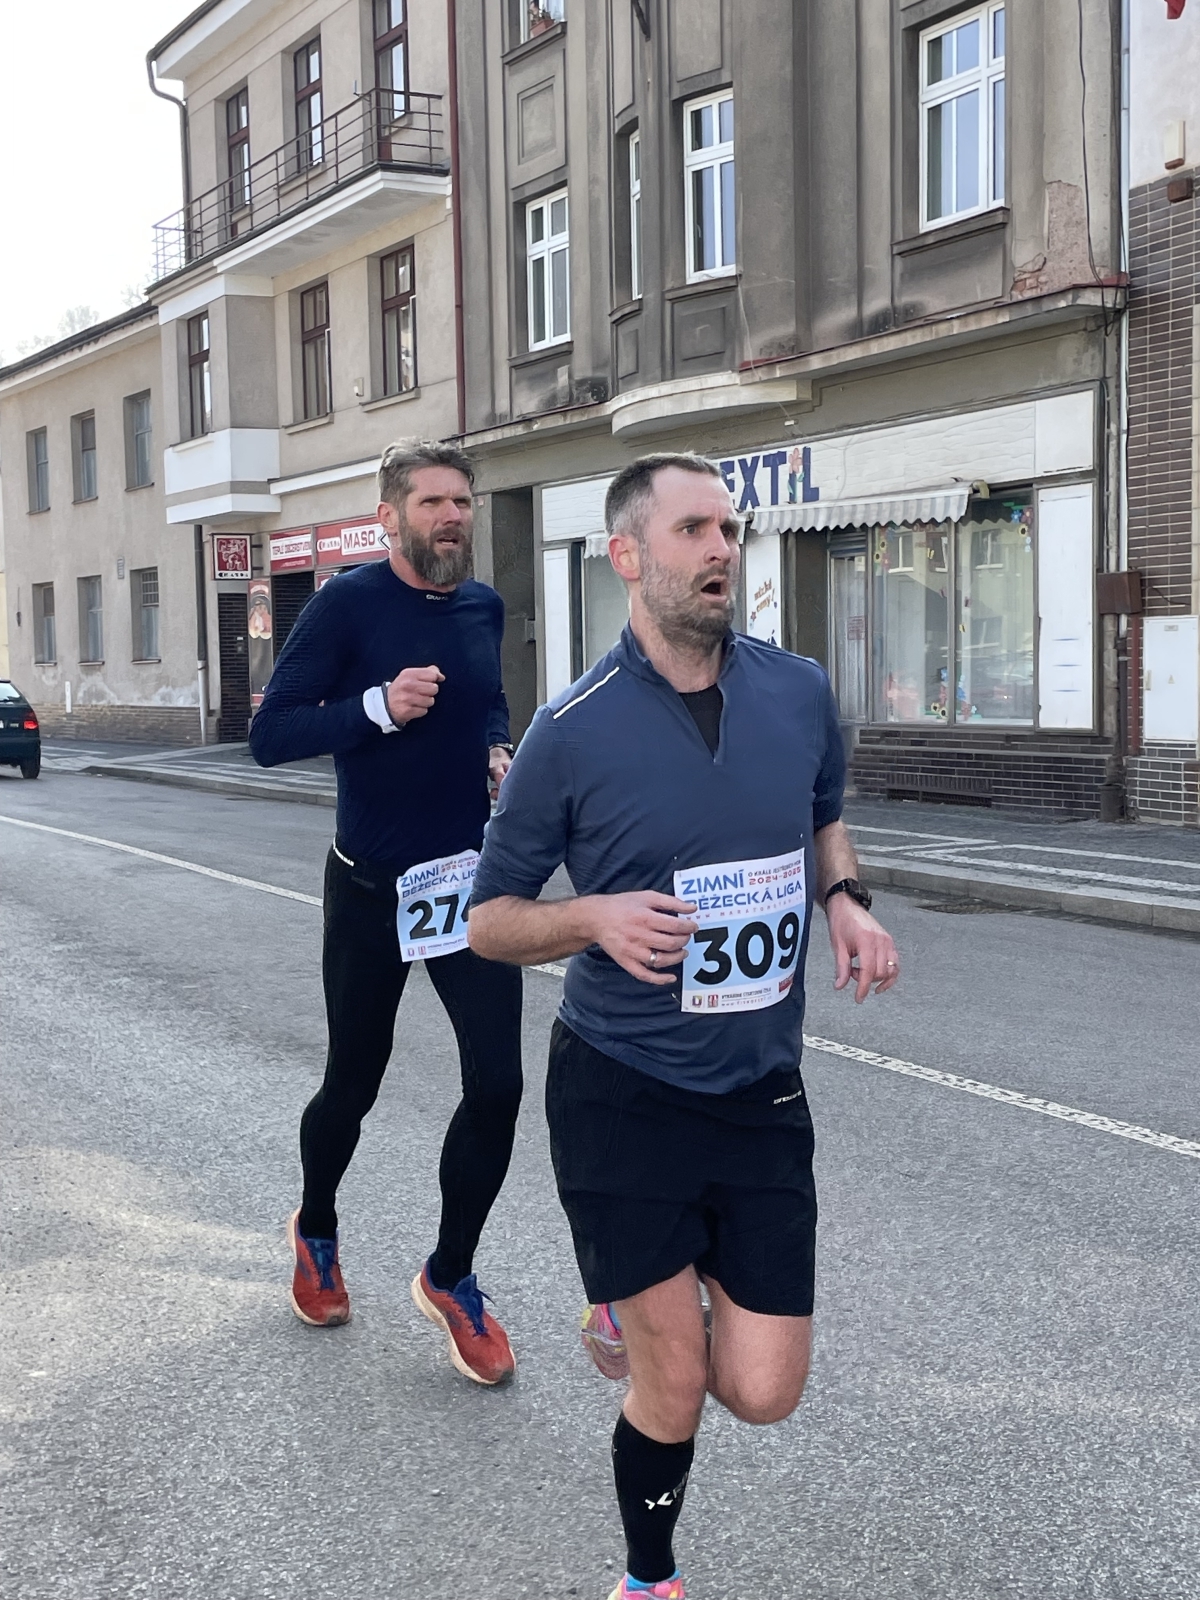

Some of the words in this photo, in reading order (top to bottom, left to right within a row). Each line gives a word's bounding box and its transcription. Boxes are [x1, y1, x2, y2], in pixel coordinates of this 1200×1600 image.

[720, 446, 819, 511] EXTIL
[343, 529, 376, 550] MASO
[401, 864, 440, 888] ZIMNÍ
[402, 872, 460, 899] BĚŽECKÁ
[462, 868, 477, 880] LIG
[681, 869, 744, 895] ZIMNÍ
[748, 866, 802, 886] 2024-2025
[776, 880, 802, 899] LIGA
[693, 911, 800, 986] 309
